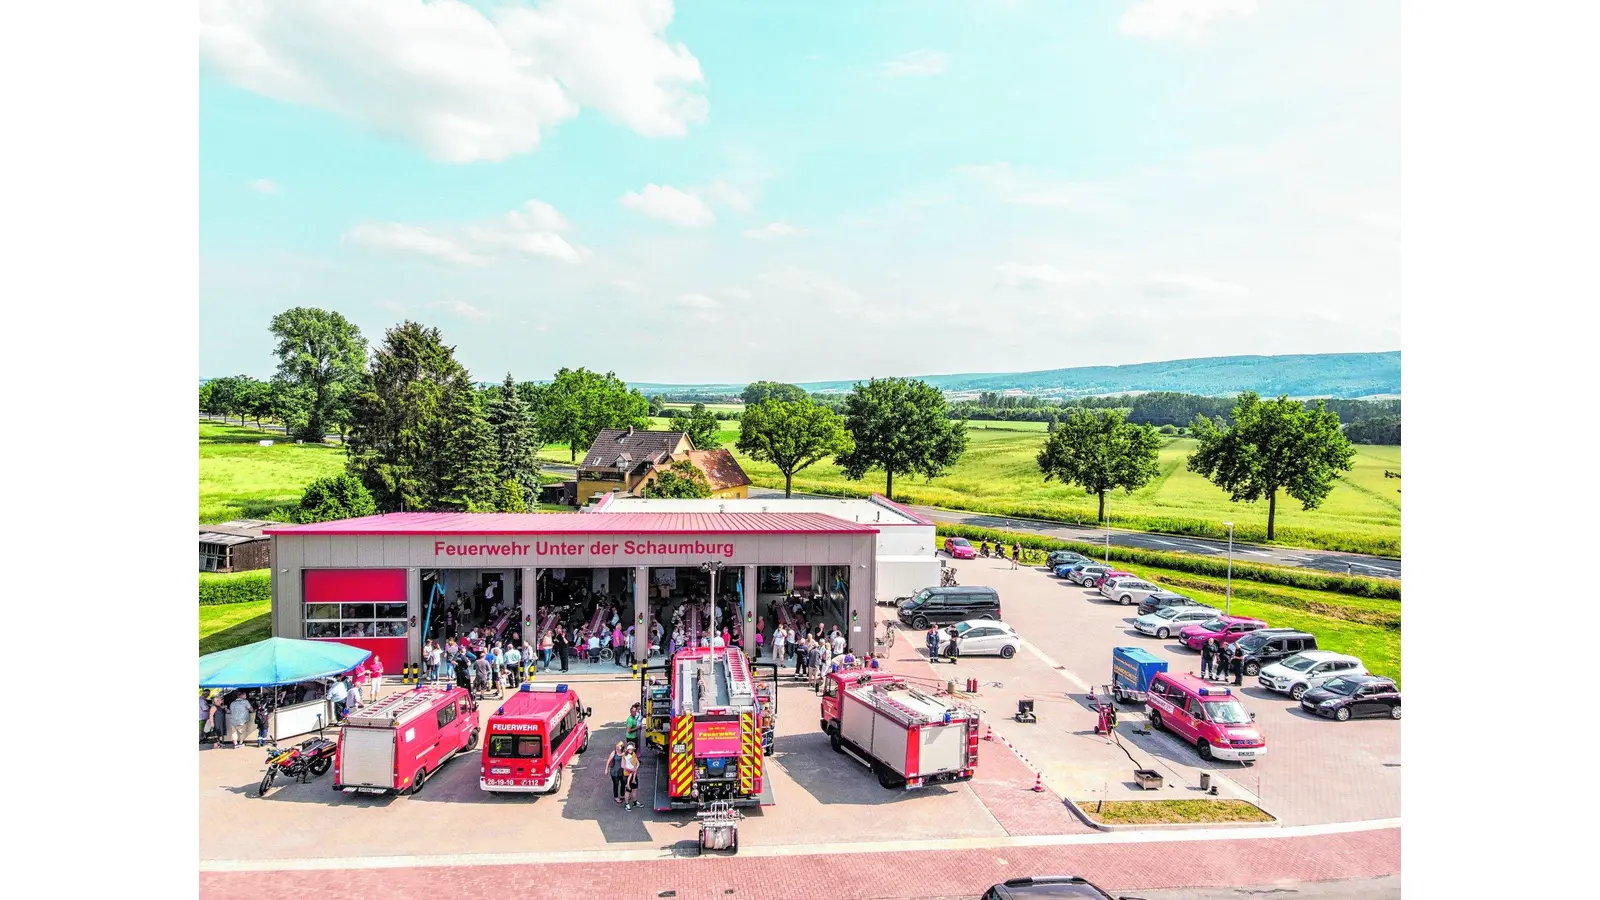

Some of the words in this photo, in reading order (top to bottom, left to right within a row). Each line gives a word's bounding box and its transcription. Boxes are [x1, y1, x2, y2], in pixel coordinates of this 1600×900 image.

[434, 541, 530, 556] Feuerwehr
[536, 541, 585, 556] Unter
[590, 540, 619, 555] der
[624, 540, 734, 557] Schaumburg
[492, 723, 538, 731] FEUERWEHR
